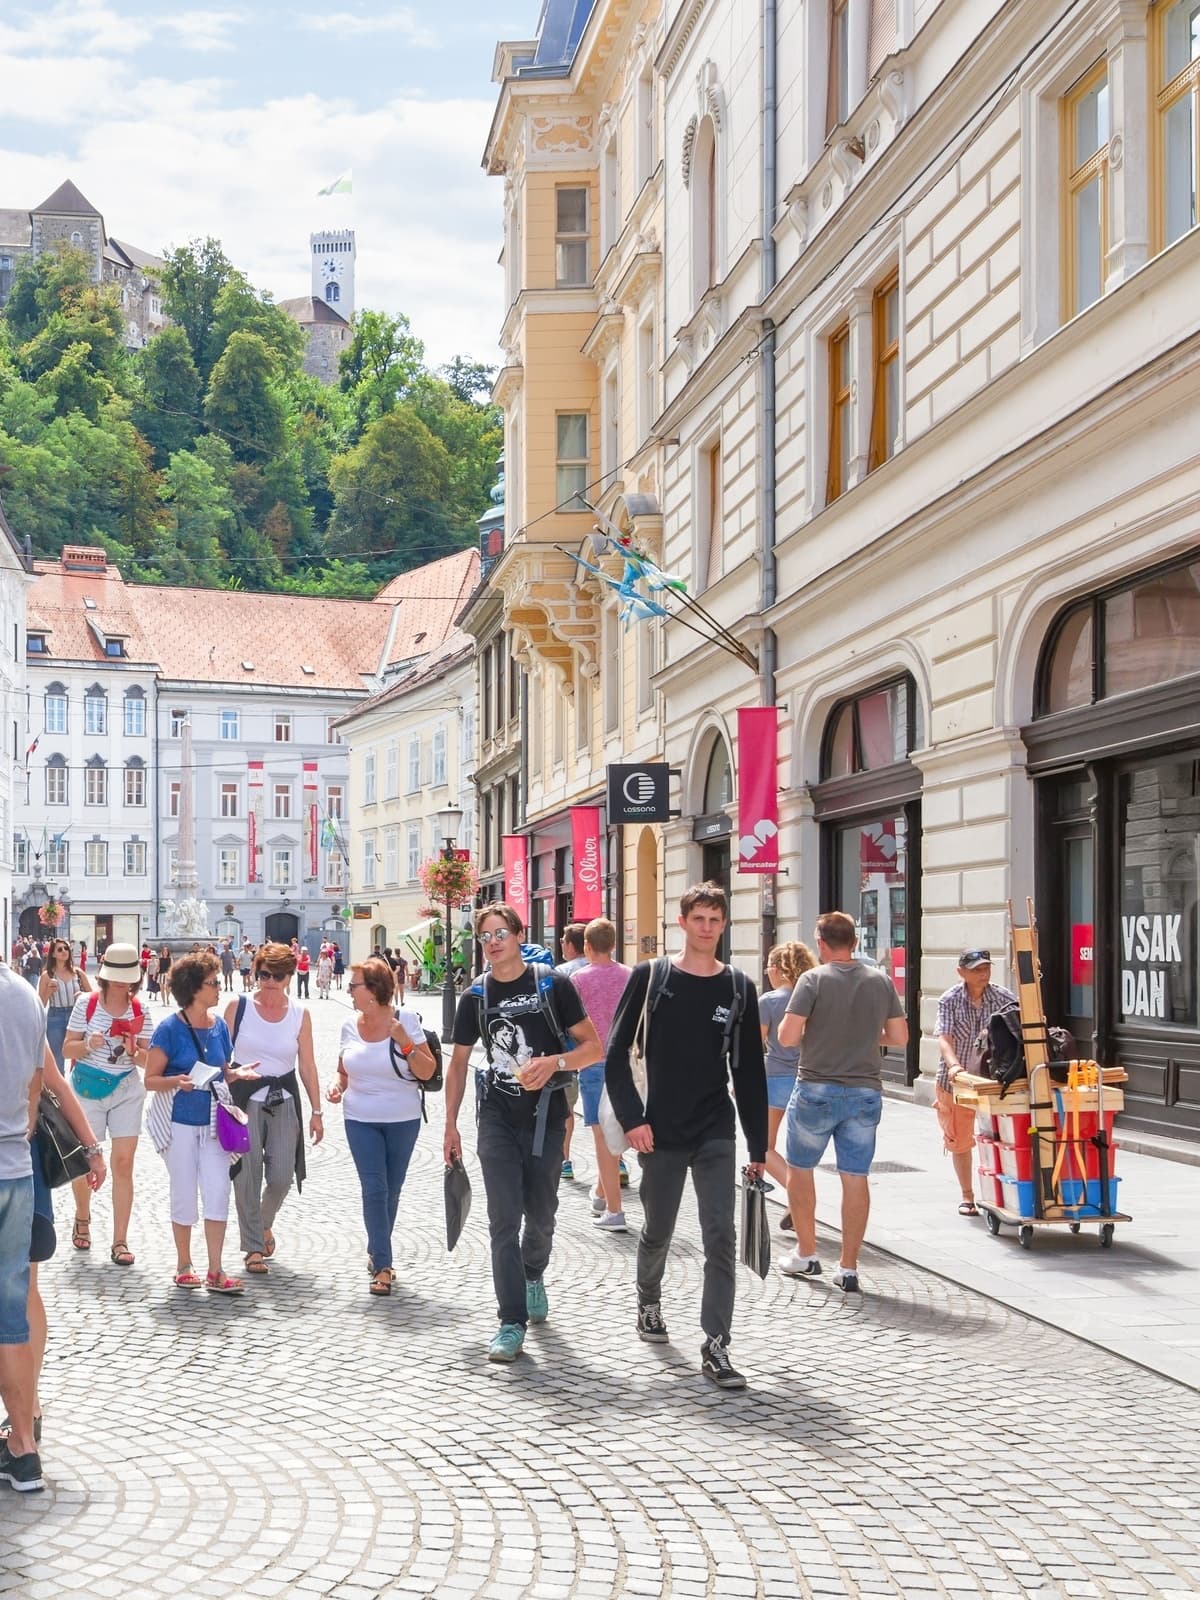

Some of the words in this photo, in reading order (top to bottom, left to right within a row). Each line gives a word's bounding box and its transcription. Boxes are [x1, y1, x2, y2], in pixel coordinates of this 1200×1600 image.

[508, 858, 525, 905] s.Oliver
[578, 835, 599, 892] s.Oliver
[739, 861, 777, 869] Mercator
[1121, 914, 1182, 962] VSAK
[1121, 969, 1165, 1018] DAN
